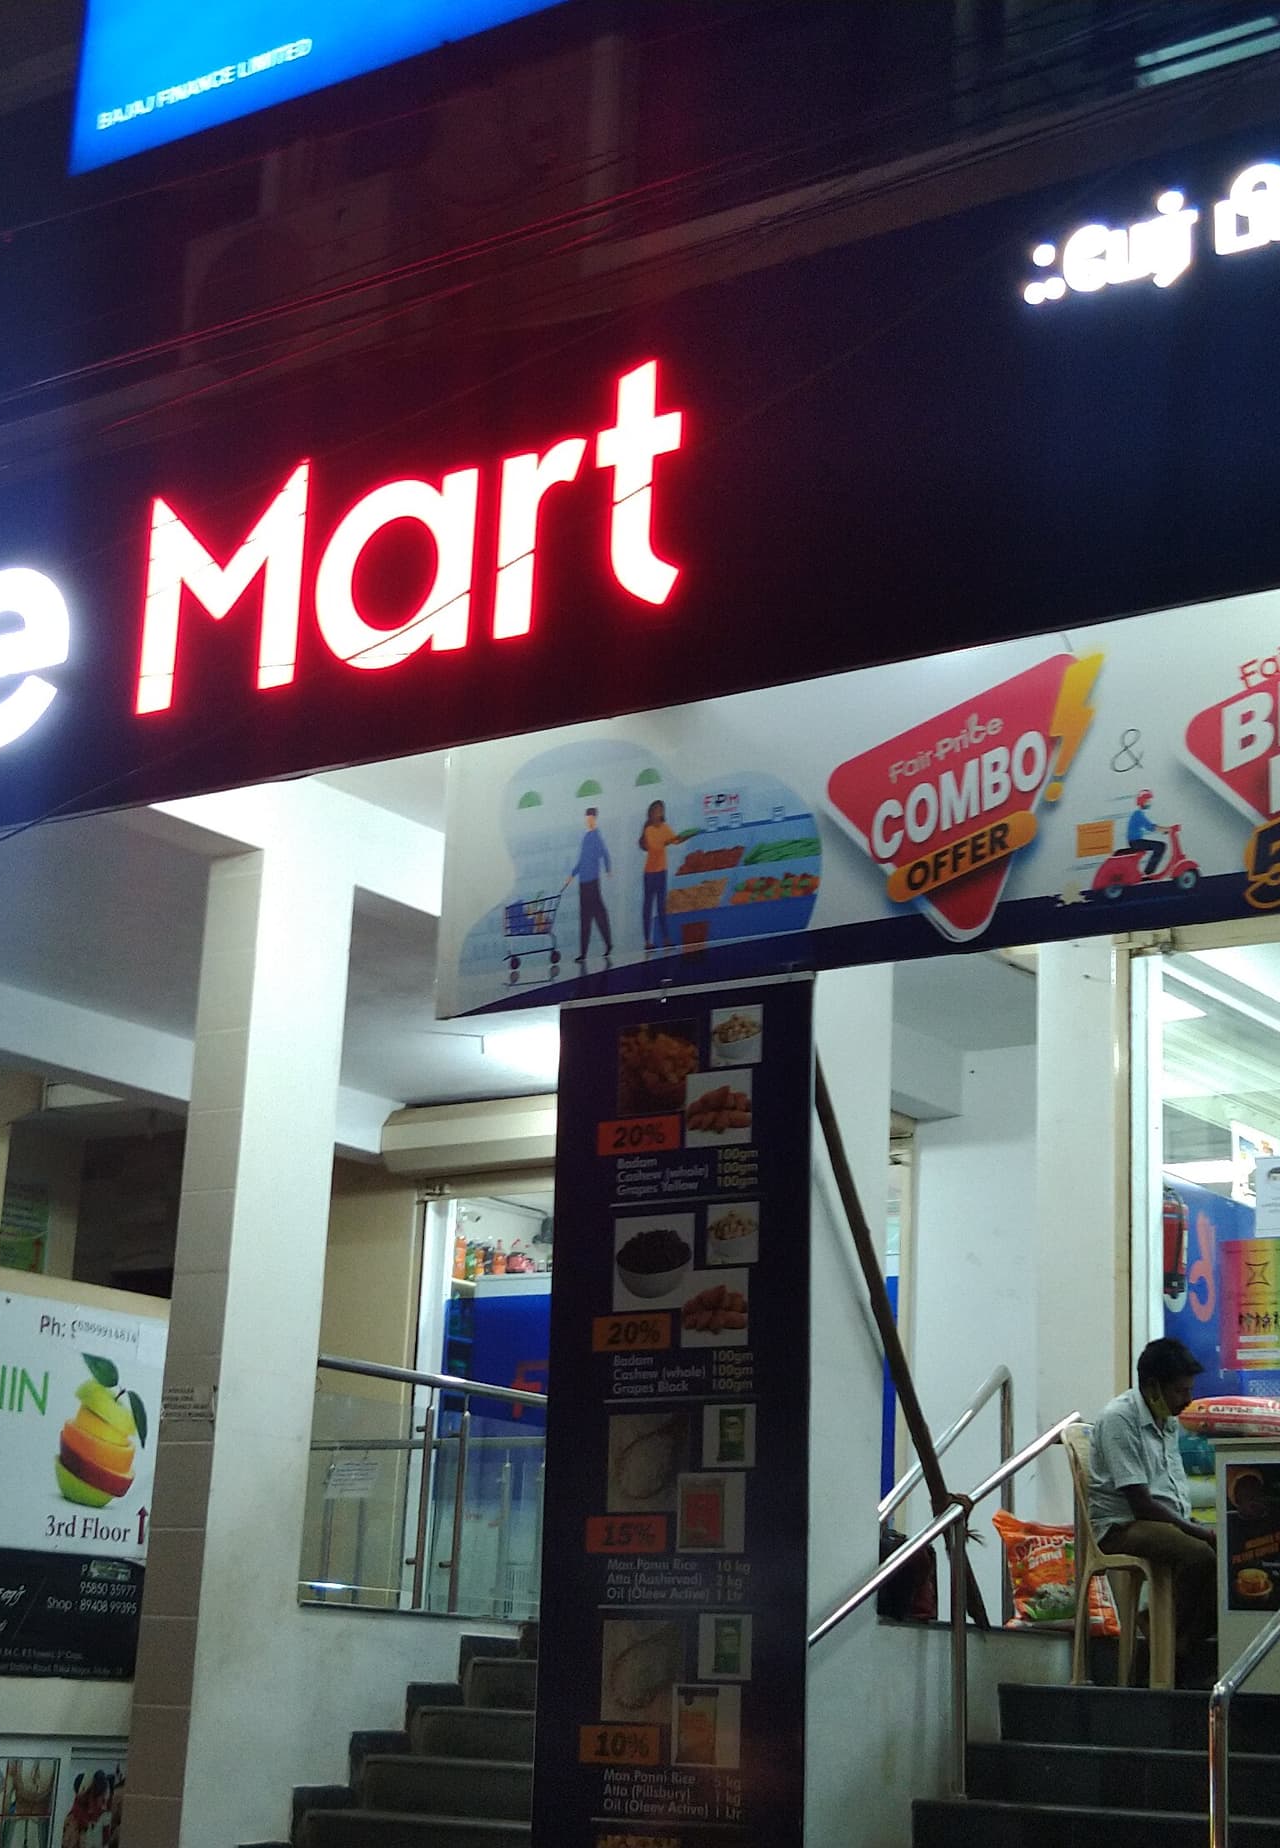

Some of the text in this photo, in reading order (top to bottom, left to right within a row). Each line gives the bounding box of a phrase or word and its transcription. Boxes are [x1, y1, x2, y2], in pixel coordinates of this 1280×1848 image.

[96, 38, 313, 130] BAJAJ FINANCE LIMITED
[1024, 189, 1198, 305] ஃபேர்
[134, 358, 684, 716] Mart
[887, 713, 1003, 784] Fair Price
[1110, 728, 1144, 773] &
[871, 731, 1048, 861] COMBO
[906, 822, 1010, 893] OFFER
[613, 1121, 665, 1149] 20%
[616, 1168, 663, 1184] Cashew
[39, 1314, 65, 1338] Ph:
[607, 1319, 661, 1345] 20%
[613, 1367, 658, 1382] Cashew
[45, 1515, 131, 1544] 3rd Floor
[594, 1731, 650, 1758] 10%
